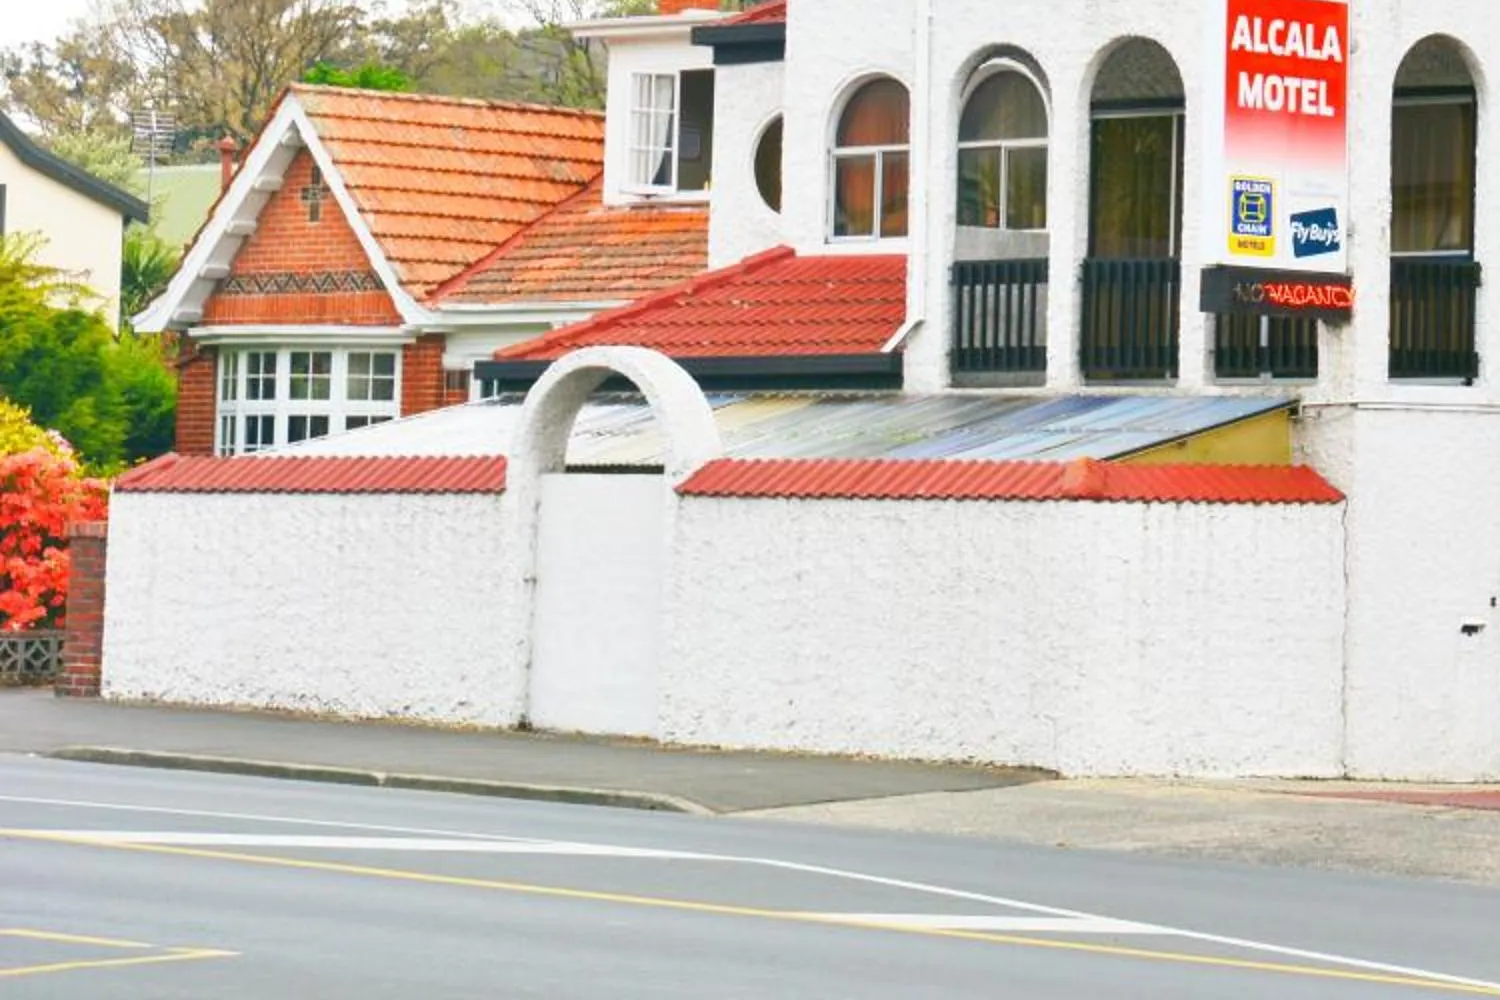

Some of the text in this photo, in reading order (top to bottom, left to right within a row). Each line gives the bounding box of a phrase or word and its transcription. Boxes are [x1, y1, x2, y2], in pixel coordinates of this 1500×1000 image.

[1232, 15, 1343, 62] ALCALA
[1238, 71, 1335, 117] MOTEL
[1237, 224, 1268, 235] CHAIN
[1234, 283, 1265, 302] NO
